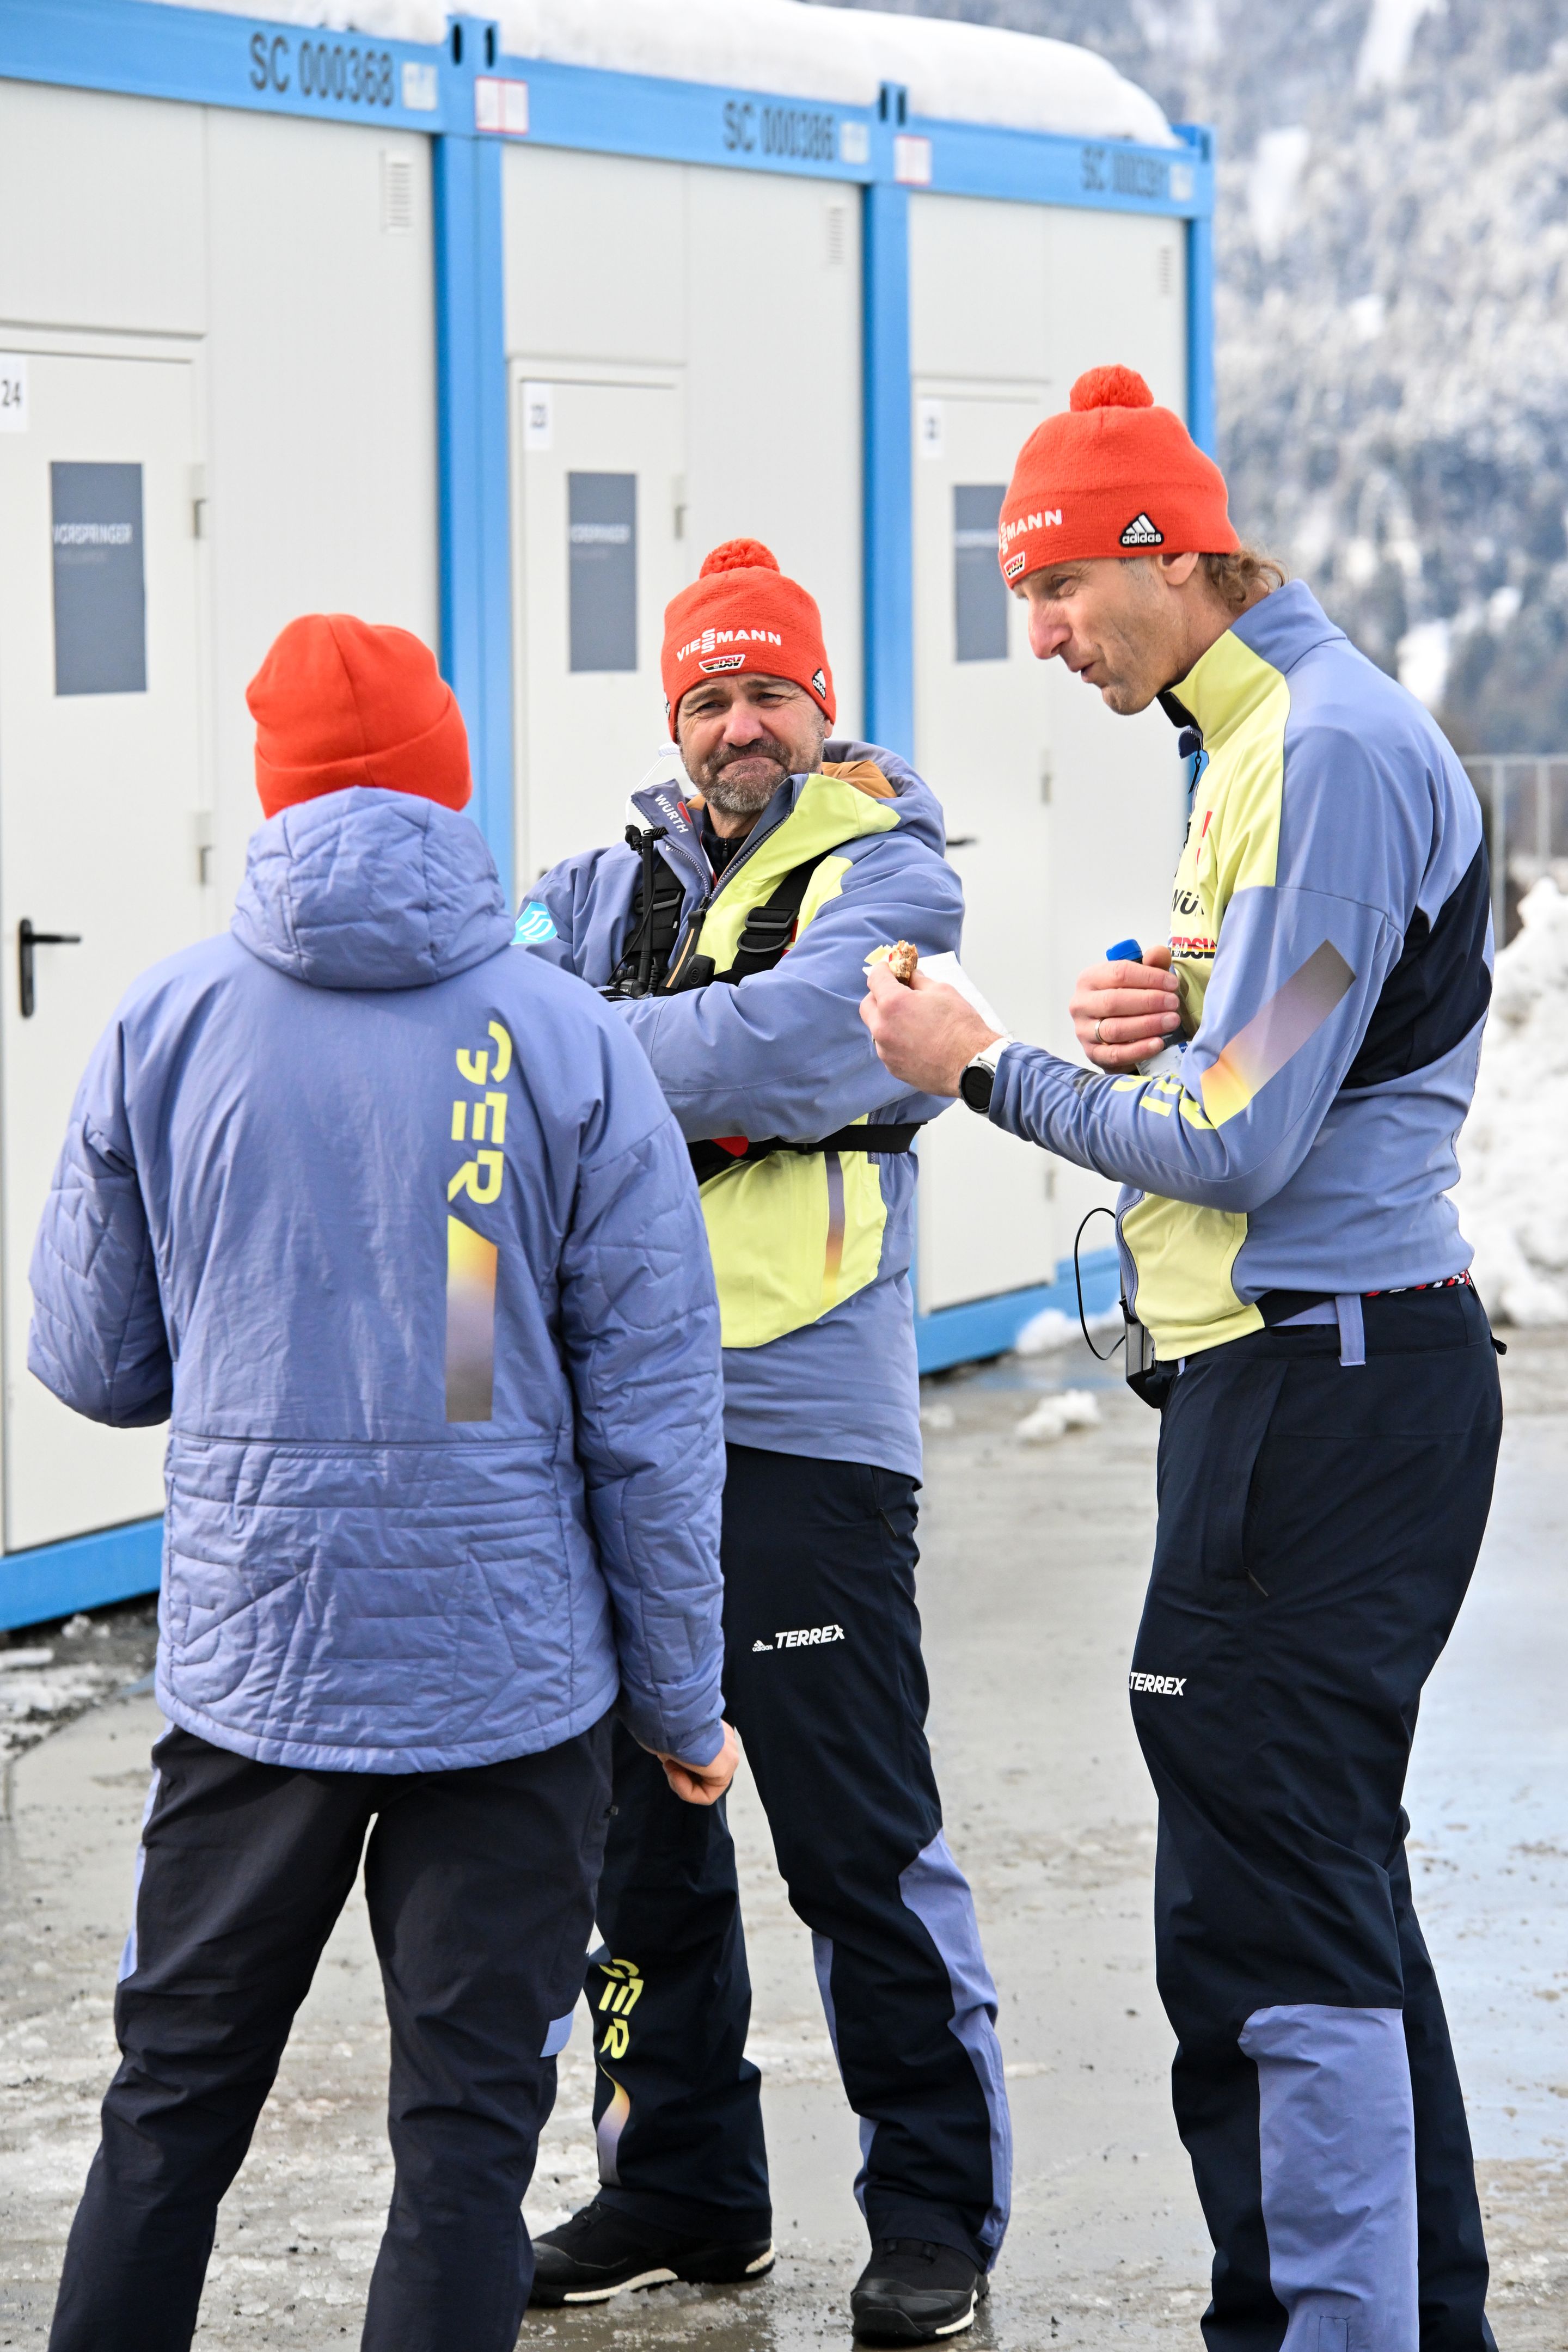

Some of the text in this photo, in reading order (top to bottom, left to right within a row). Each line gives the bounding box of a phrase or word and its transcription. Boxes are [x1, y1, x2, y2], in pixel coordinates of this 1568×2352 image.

[249, 31, 290, 92] SC
[299, 40, 394, 106] 000368
[723, 100, 756, 153] SC
[2, 379, 22, 408] 24
[1122, 532, 1162, 545] adidas
[677, 628, 782, 661] VIESSMANN
[655, 794, 689, 833] WÜRTH
[448, 1020, 513, 1205] GER
[775, 1624, 845, 1649] TERREX
[1130, 1671, 1187, 1696] TERREX
